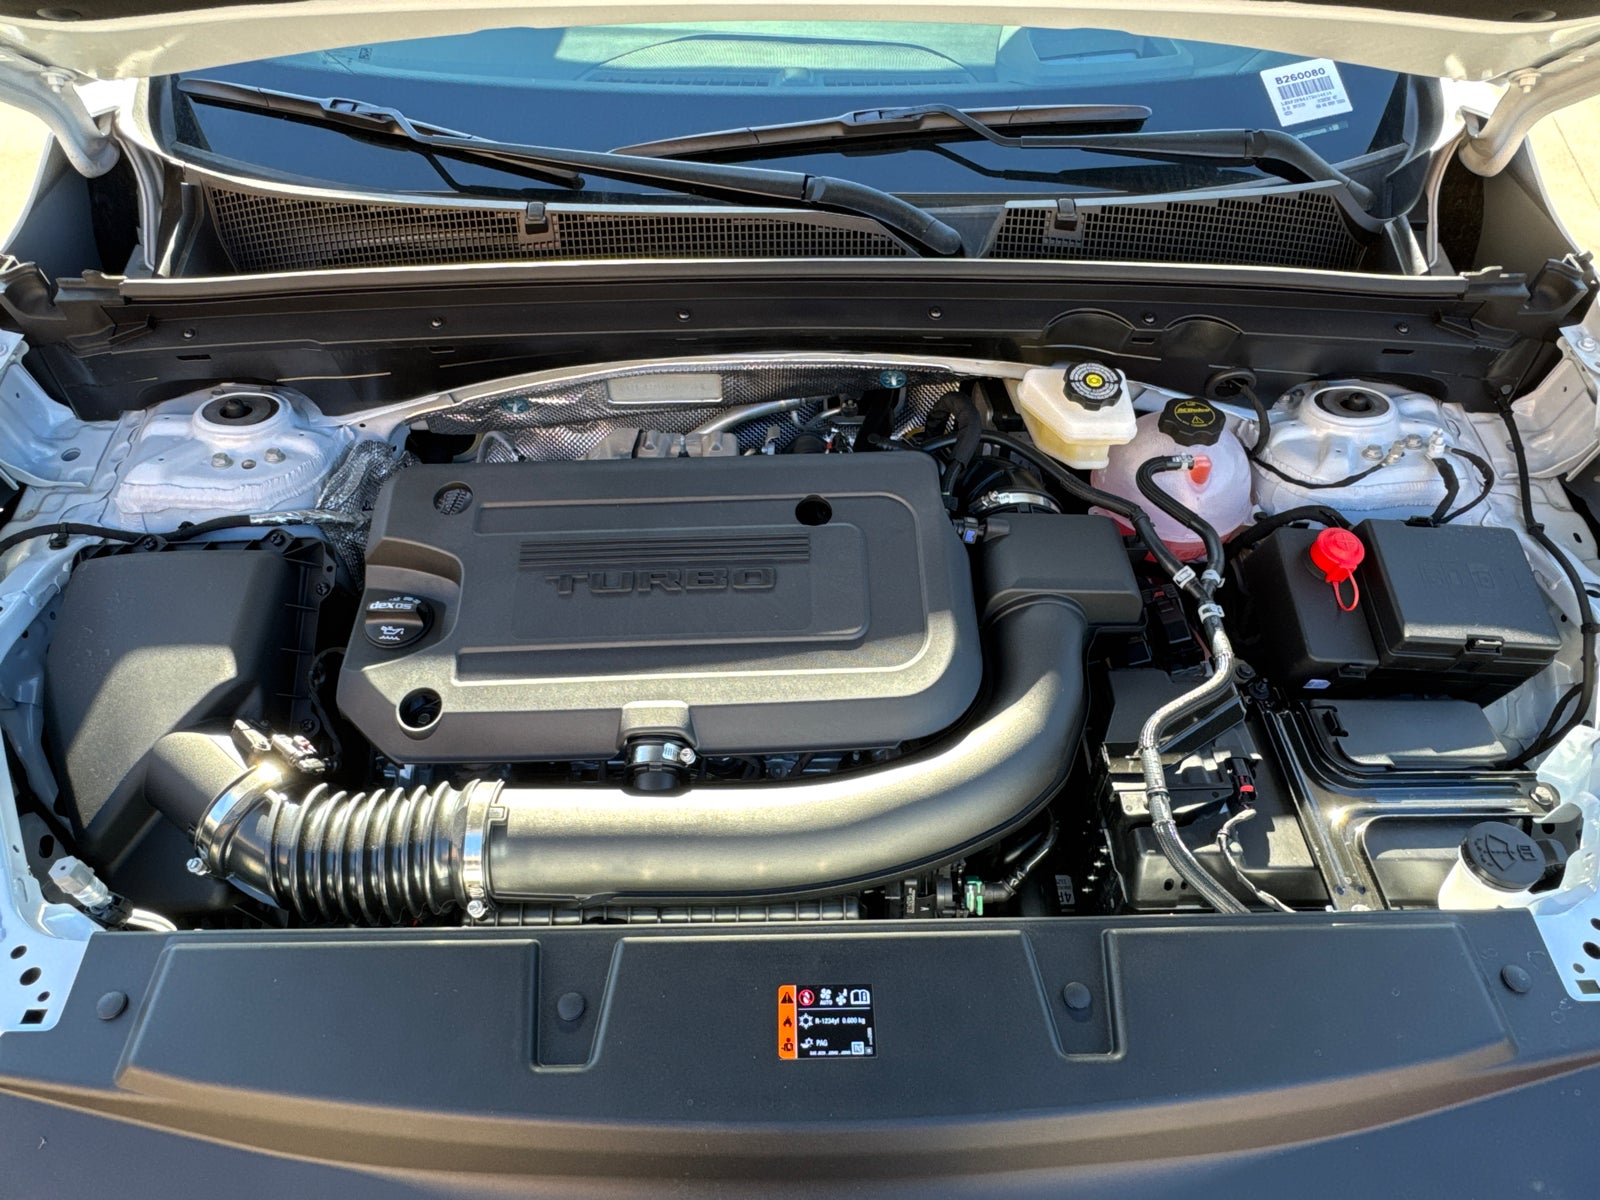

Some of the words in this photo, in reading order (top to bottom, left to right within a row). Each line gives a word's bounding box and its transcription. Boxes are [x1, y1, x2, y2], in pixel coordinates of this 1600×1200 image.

[1275, 68, 1325, 84] B260080
[545, 567, 777, 596] TURBO
[369, 601, 413, 610] dexos
